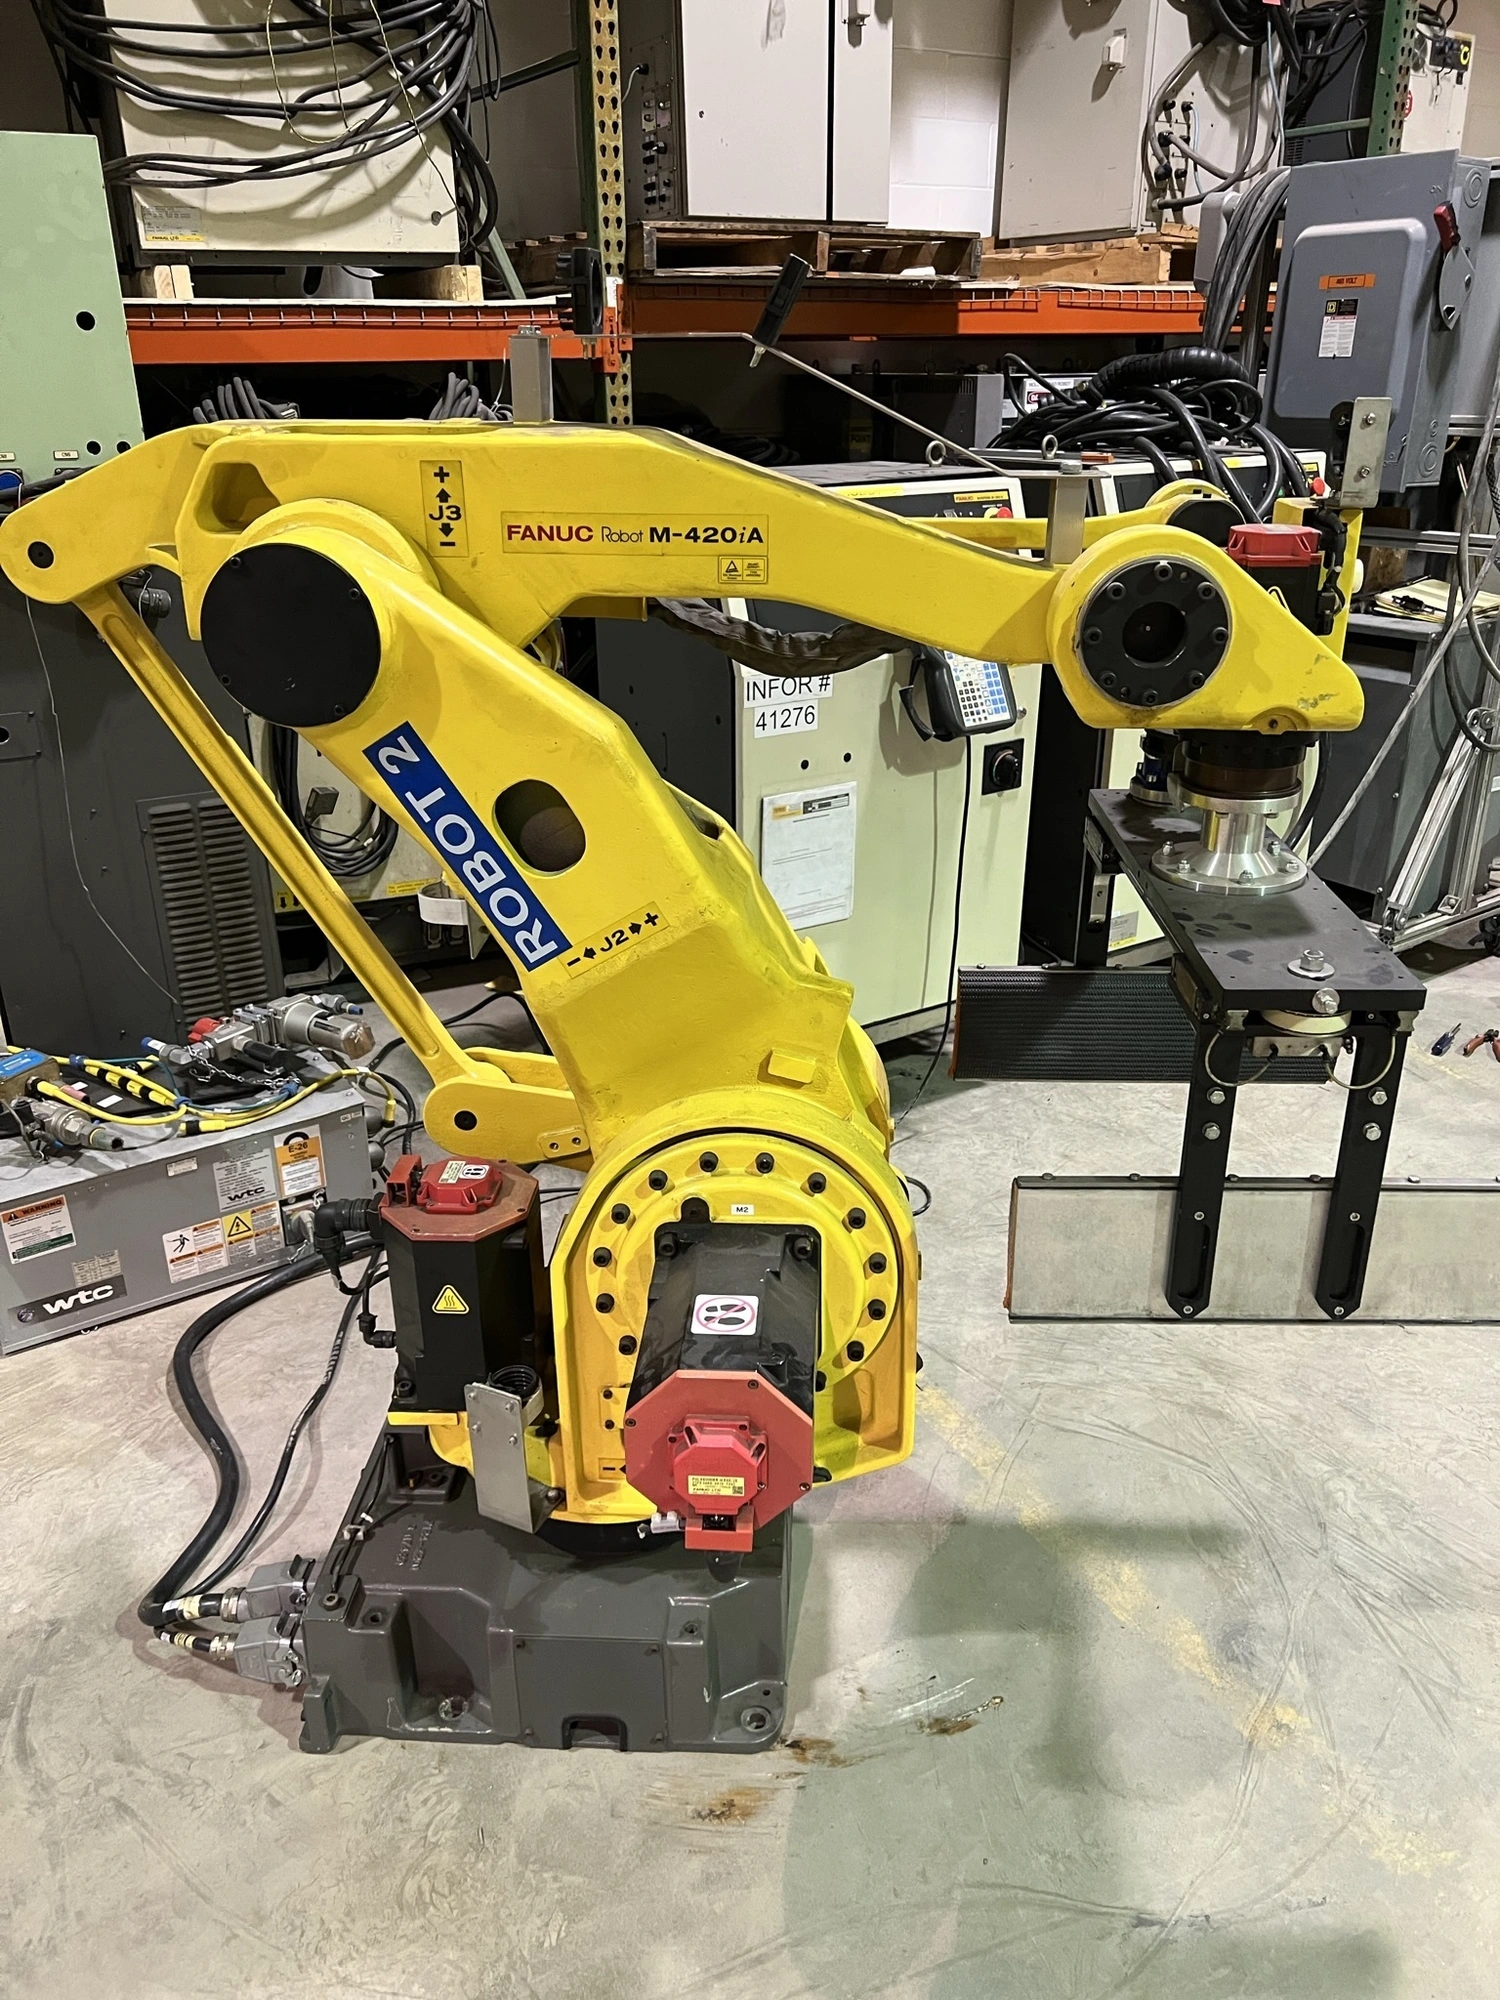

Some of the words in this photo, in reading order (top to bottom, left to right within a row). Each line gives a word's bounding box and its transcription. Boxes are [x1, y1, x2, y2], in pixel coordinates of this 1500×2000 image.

[428, 504, 462, 521] J3
[506, 524, 594, 542] FANUC
[601, 526, 644, 543] Robot
[649, 526, 764, 544] M-420iA
[746, 676, 813, 702] INFOR
[818, 675, 831, 692] #
[755, 704, 816, 732] 41276
[378, 735, 421, 774] 2
[404, 786, 559, 964] ROBOT
[600, 929, 630, 953] J2
[288, 1142, 308, 1153] E-26
[227, 1186, 266, 1202] wtc
[22, 1199, 63, 1216] WARNING
[42, 1284, 115, 1315] wtc
